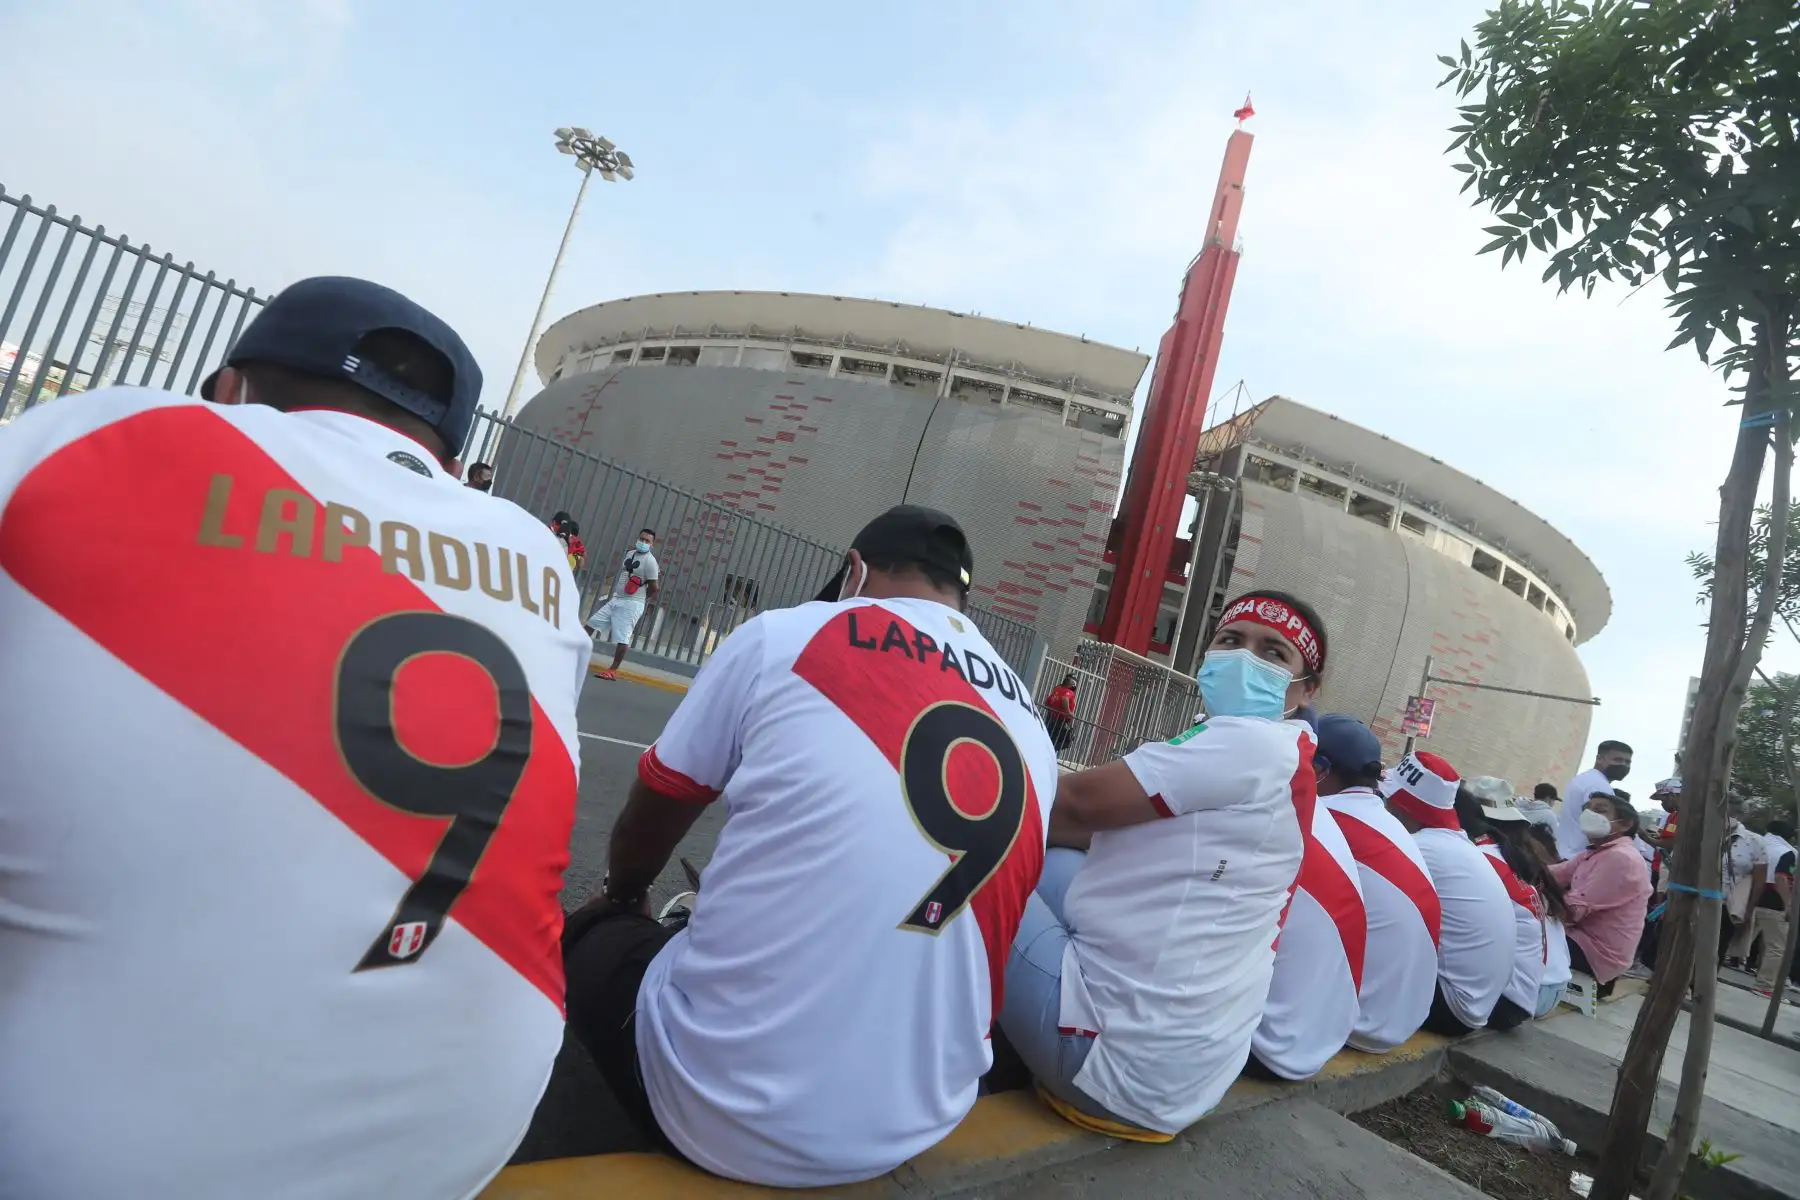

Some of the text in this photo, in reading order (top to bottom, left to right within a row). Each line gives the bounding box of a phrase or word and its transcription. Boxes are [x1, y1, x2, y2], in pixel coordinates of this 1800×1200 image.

[195, 473, 561, 630] LAPADULA
[332, 610, 534, 973] 9
[896, 700, 1027, 938] 9
[1396, 753, 1424, 787] eru
